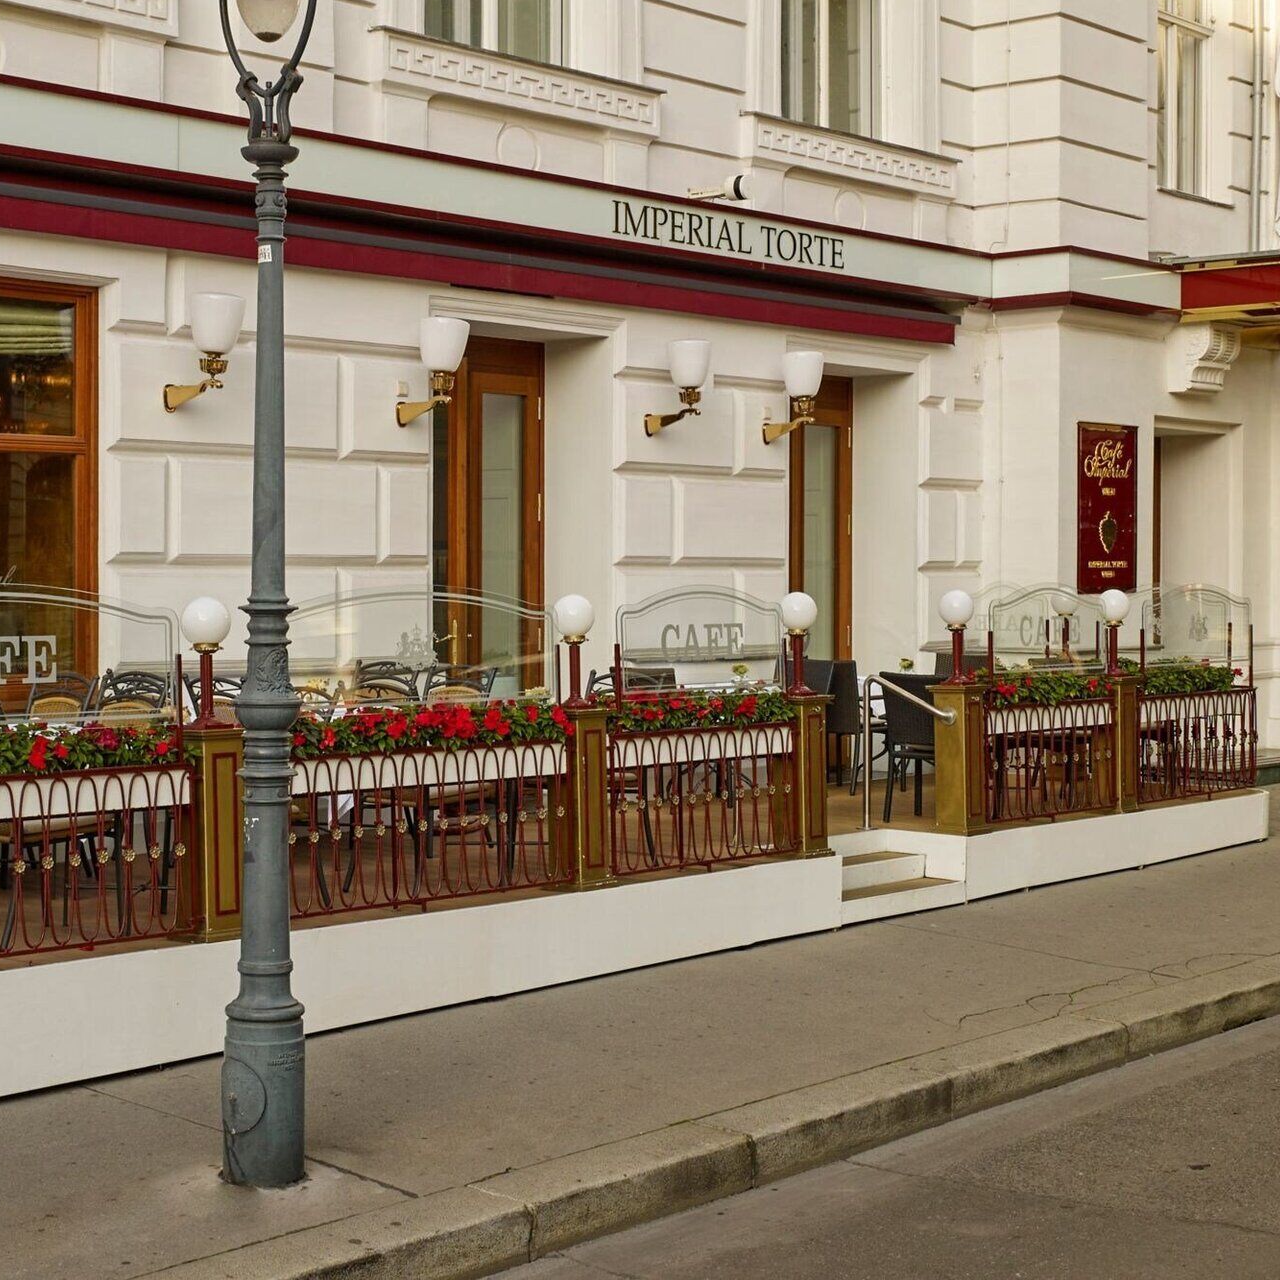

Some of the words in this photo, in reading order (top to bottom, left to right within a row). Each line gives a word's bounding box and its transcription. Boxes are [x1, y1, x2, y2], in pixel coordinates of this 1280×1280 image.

[611, 199, 753, 255] IMPERIAL
[760, 224, 845, 270] TORTE
[1094, 439, 1125, 470] Café
[661, 623, 745, 662] CAFE
